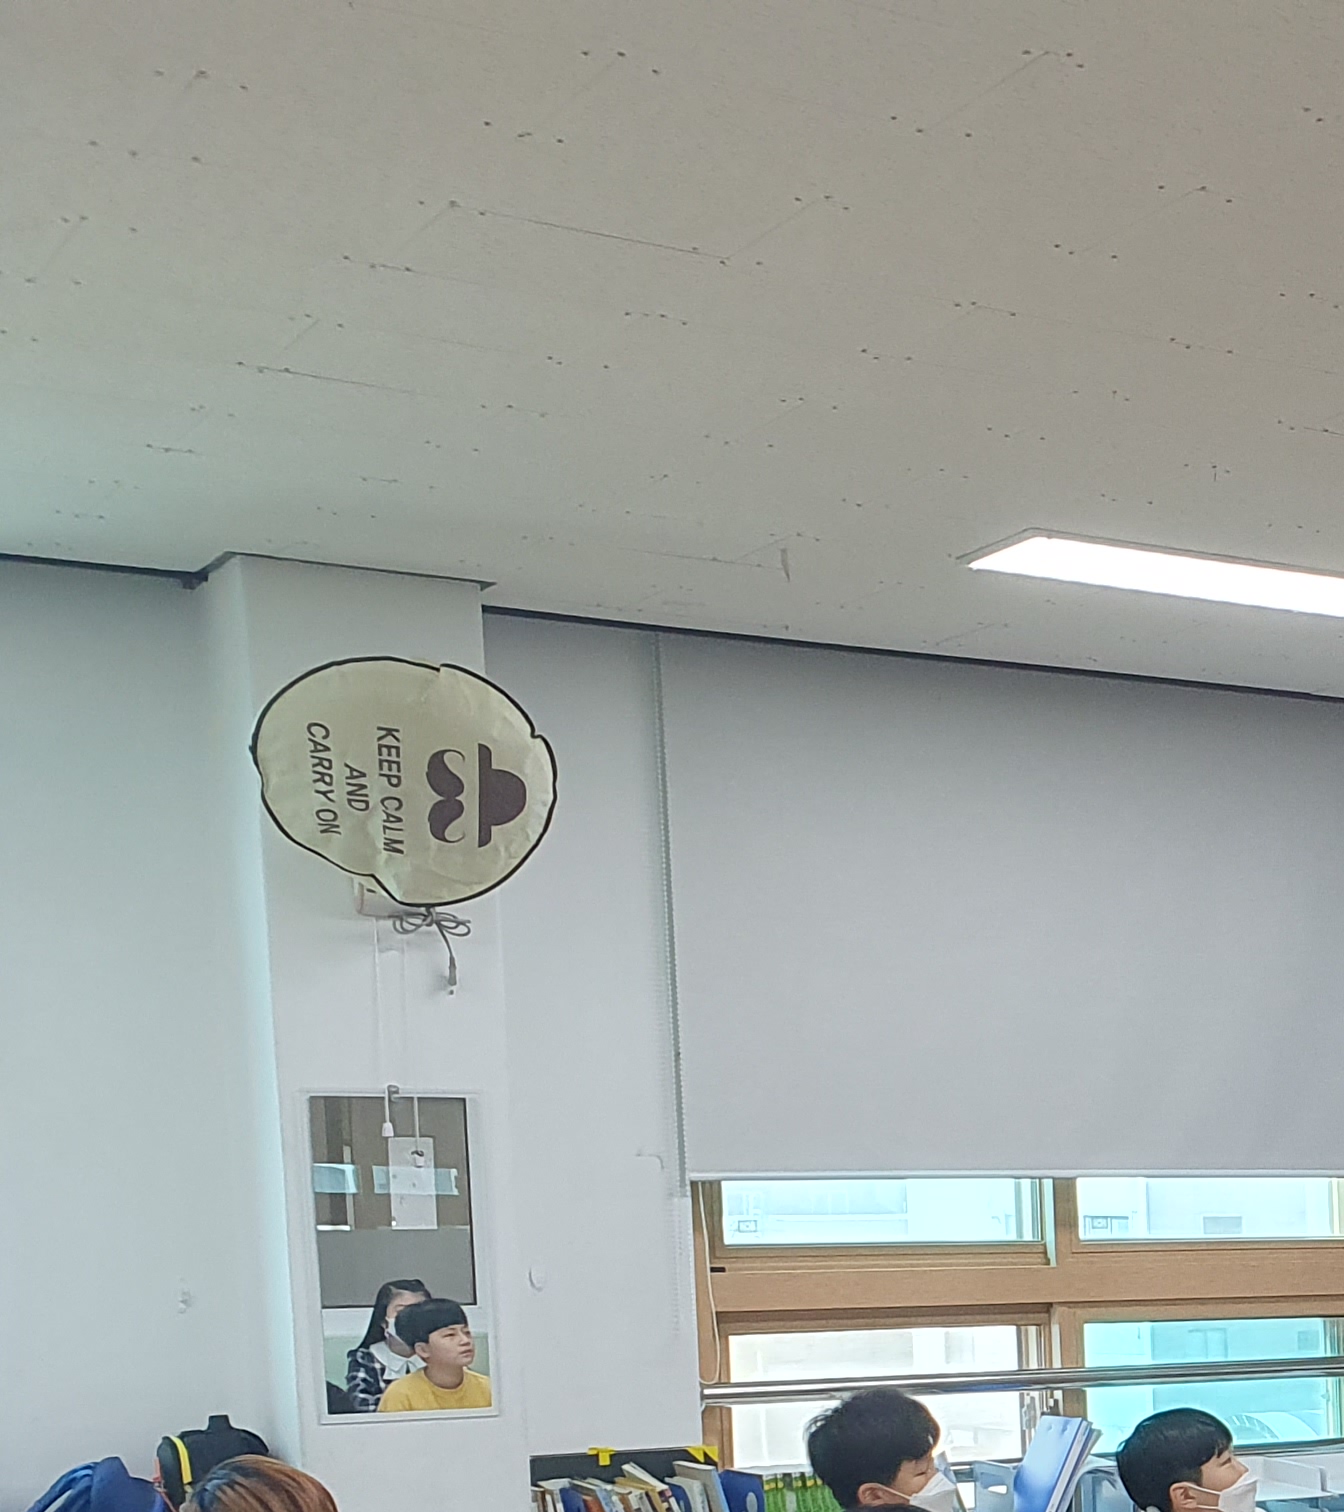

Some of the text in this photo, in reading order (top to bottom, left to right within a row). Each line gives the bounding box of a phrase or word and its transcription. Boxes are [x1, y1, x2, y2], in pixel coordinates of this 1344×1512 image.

[306, 721, 342, 836] CARRY ON
[344, 763, 370, 812] AND
[376, 725, 405, 855] KEEP CALM
